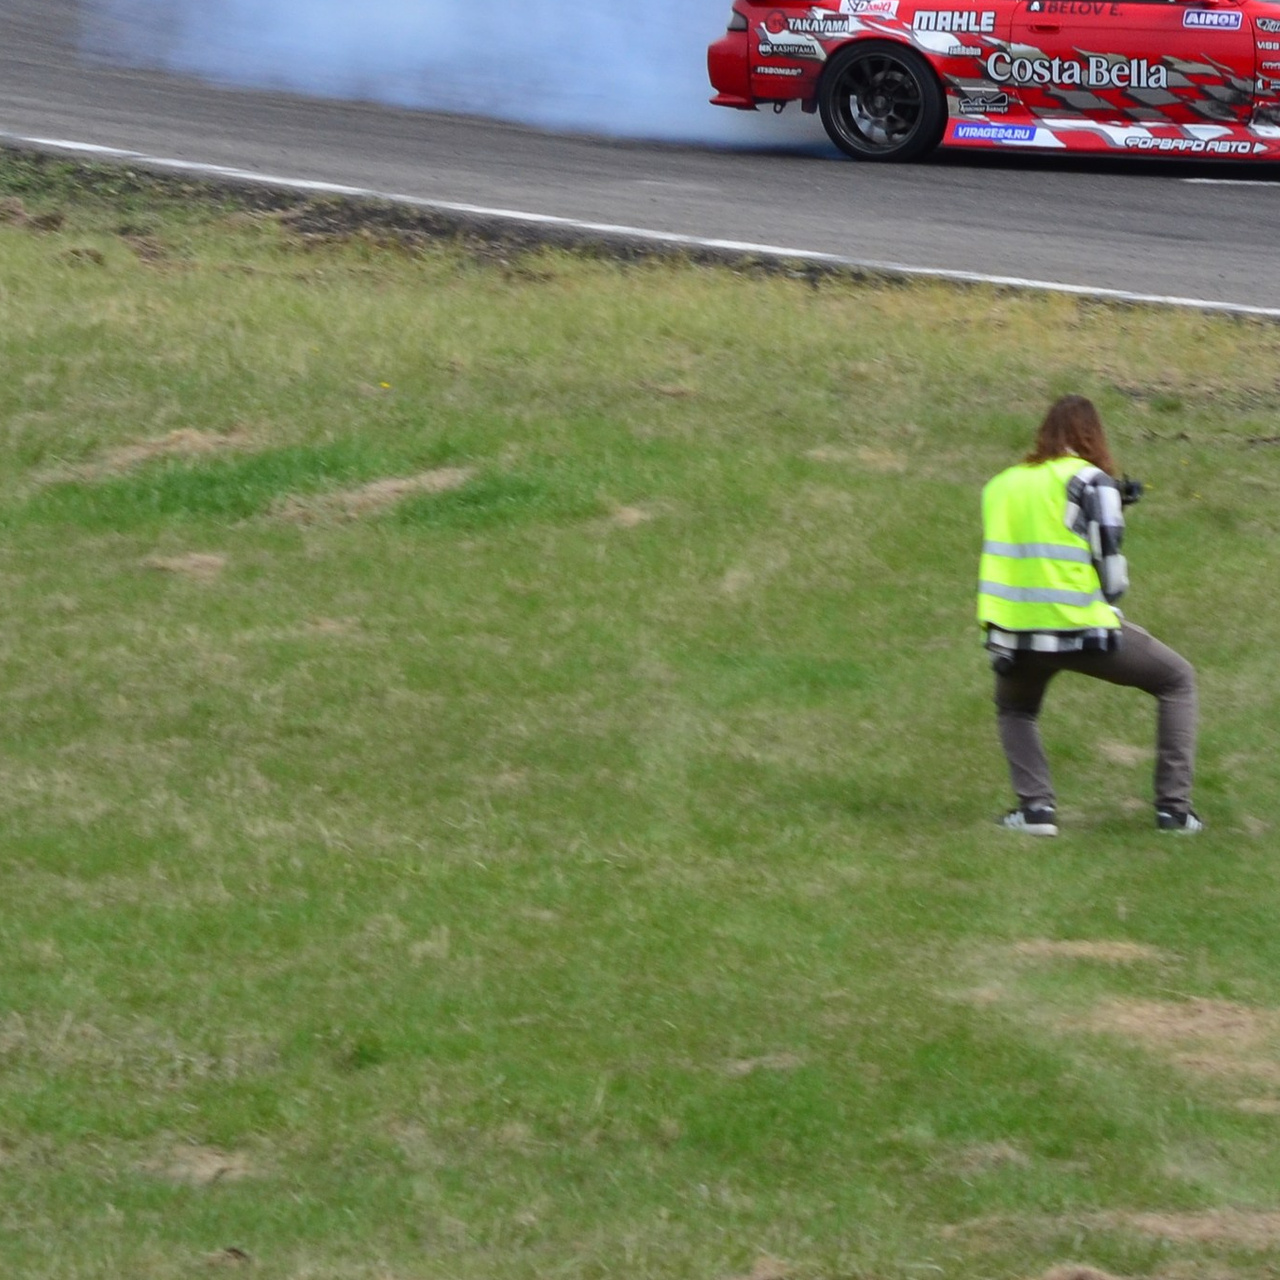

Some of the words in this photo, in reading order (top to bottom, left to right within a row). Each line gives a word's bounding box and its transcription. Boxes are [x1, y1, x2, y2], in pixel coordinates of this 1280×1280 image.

[1047, 1, 1105, 16] BELOV
[786, 17, 850, 33] TAKAYAMA
[912, 10, 996, 33] MAHLE
[1185, 12, 1239, 26] AIMOL
[773, 42, 817, 55] KASHIYAMA
[958, 125, 1031, 140] VIRAGE24.RU
